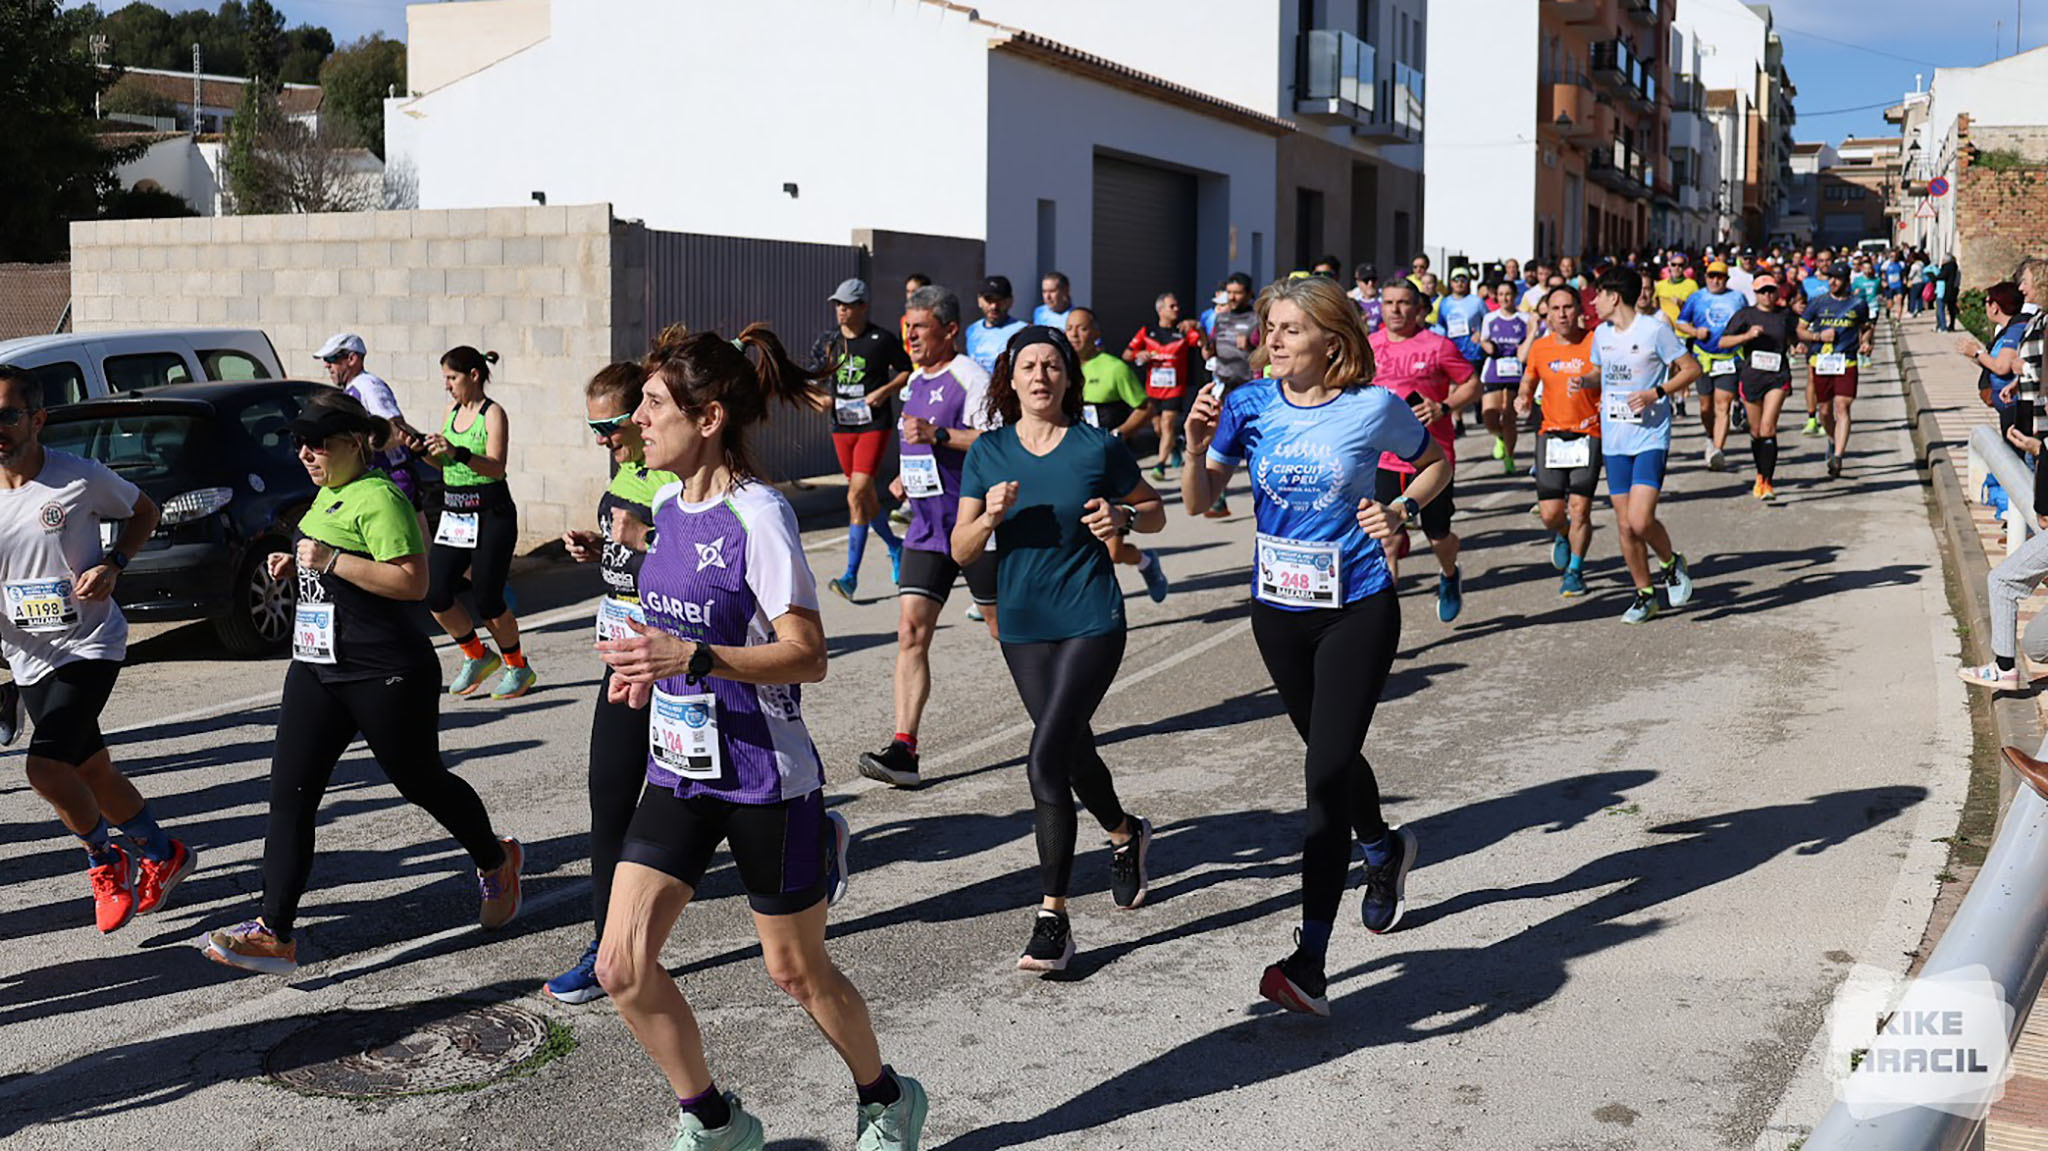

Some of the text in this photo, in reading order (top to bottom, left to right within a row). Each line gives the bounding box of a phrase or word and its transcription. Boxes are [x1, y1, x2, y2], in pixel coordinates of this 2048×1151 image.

[1272, 464, 1325, 475] CIRCUIT
[1278, 475, 1319, 485] A PEU
[1280, 571, 1309, 589] 248
[16, 603, 59, 617] A 1198
[638, 591, 715, 627] LGARBÍ
[609, 623, 626, 639] 351
[299, 632, 315, 647] 199
[662, 729, 683, 755] 124
